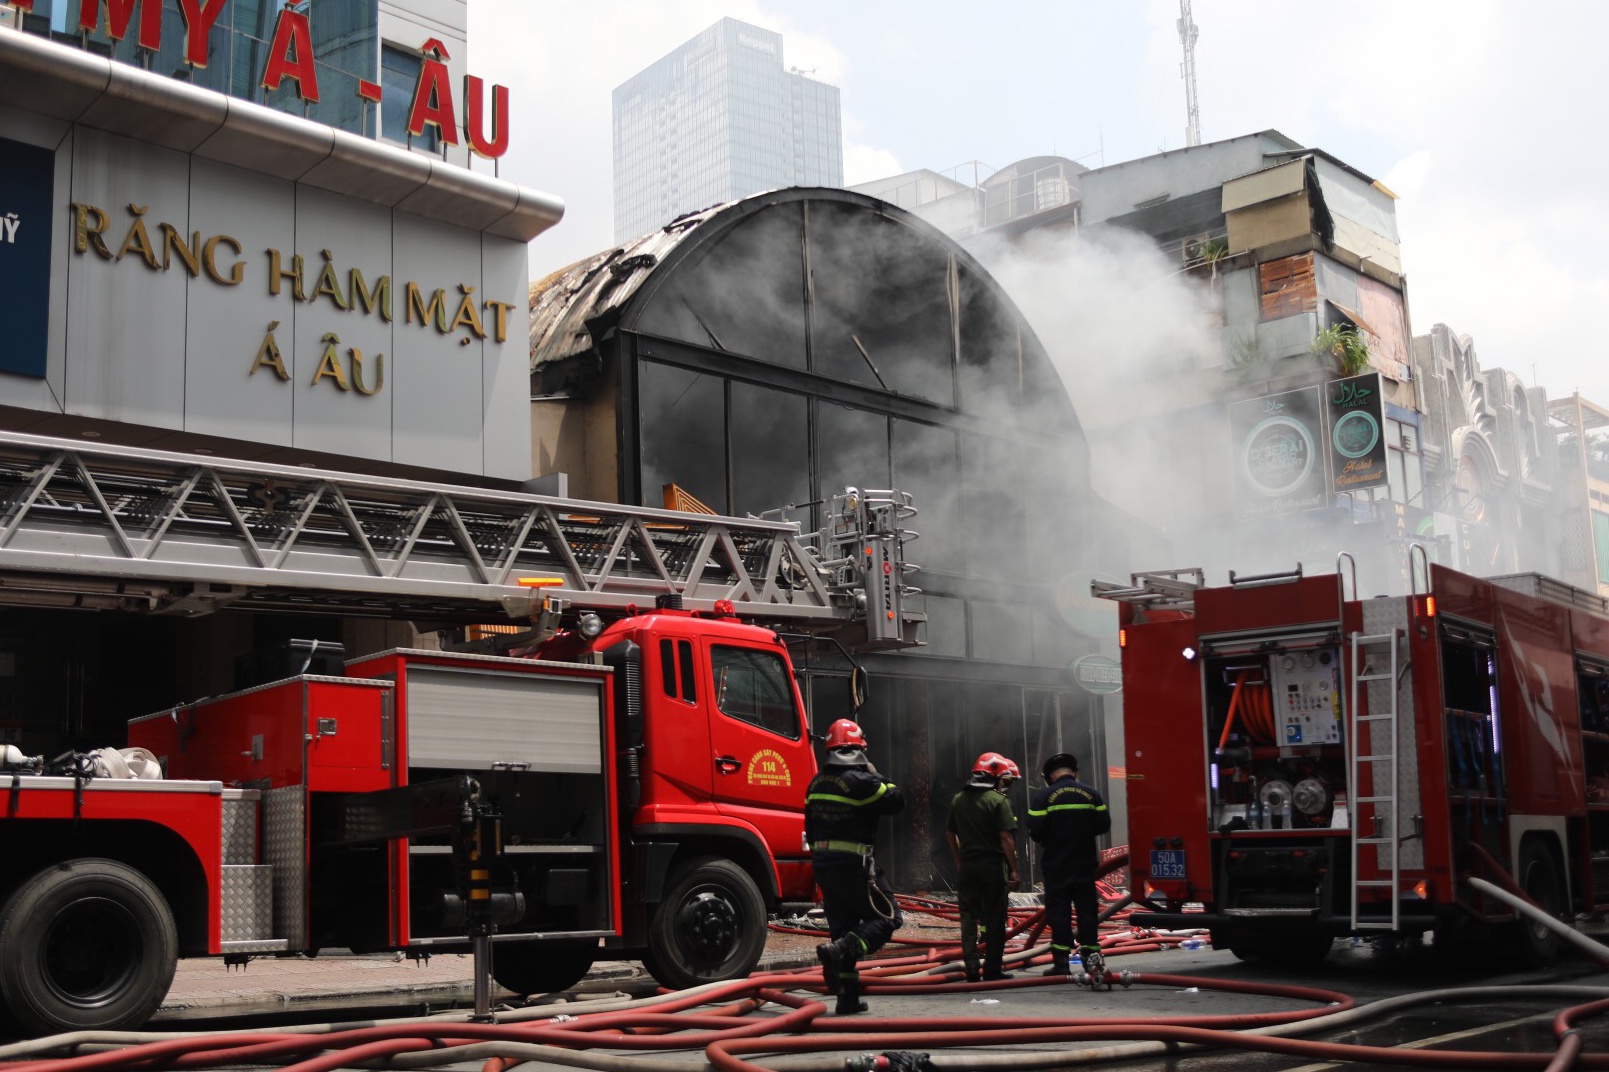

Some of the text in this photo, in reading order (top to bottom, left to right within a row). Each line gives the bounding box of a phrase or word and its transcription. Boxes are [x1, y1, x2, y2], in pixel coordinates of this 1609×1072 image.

[406, 37, 510, 159] ÂU
[0, 211, 21, 244] Ỹ
[70, 203, 517, 347] RĂNG HÀM MẶT
[249, 320, 385, 396] Á ÂU
[1333, 381, 1372, 404] حلال
[1342, 400, 1369, 409] HALAL
[1343, 457, 1374, 474] Halal
[1334, 470, 1383, 488] Restaurant
[882, 546, 893, 610] MORITA
[762, 761, 776, 772] 114
[1158, 851, 1176, 864] 50A
